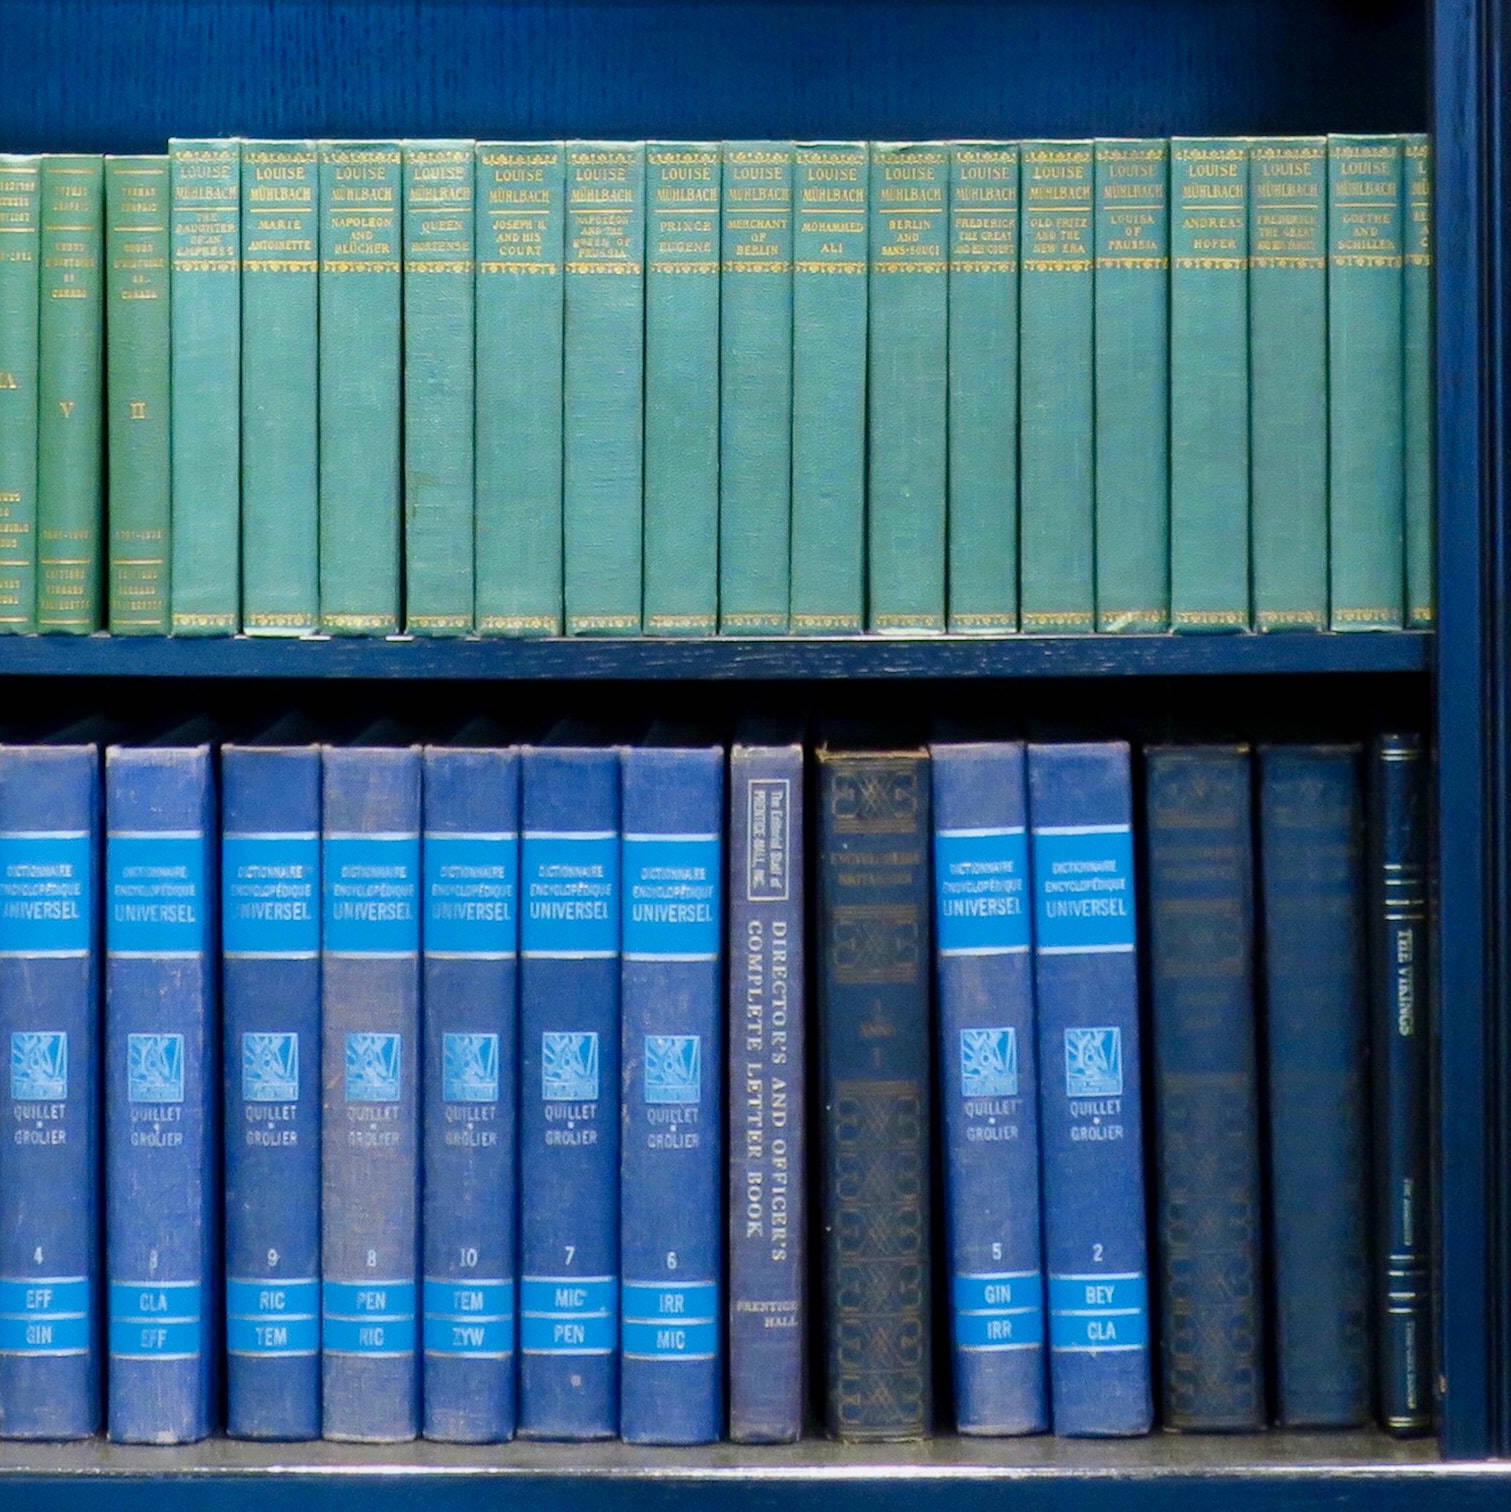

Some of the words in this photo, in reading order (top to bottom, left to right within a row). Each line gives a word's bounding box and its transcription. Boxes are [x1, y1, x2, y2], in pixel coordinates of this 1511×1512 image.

[257, 167, 304, 180] LOUISE
[250, 185, 311, 201] MÜHLBACH
[258, 220, 301, 230] MARIE
[660, 221, 711, 232] PRINCE
[249, 240, 311, 251] ANTOINETTE
[659, 241, 711, 253] EUGENE
[529, 900, 609, 922] UNIVERSEL
[1398, 930, 1413, 962] THE
[747, 921, 763, 1051] COMPLETE
[772, 921, 787, 1065] DIRECTOR'S
[1398, 967, 1415, 1036] VIKINGS
[747, 1062, 763, 1158] LETTER
[772, 1077, 787, 1128] AND
[544, 1104, 597, 1123] QUILLET
[544, 1129, 598, 1146] GROLIER
[747, 1172, 763, 1238] BOOK
[772, 1139, 787, 1261] OFFICER'S
[555, 1288, 584, 1308] MIC
